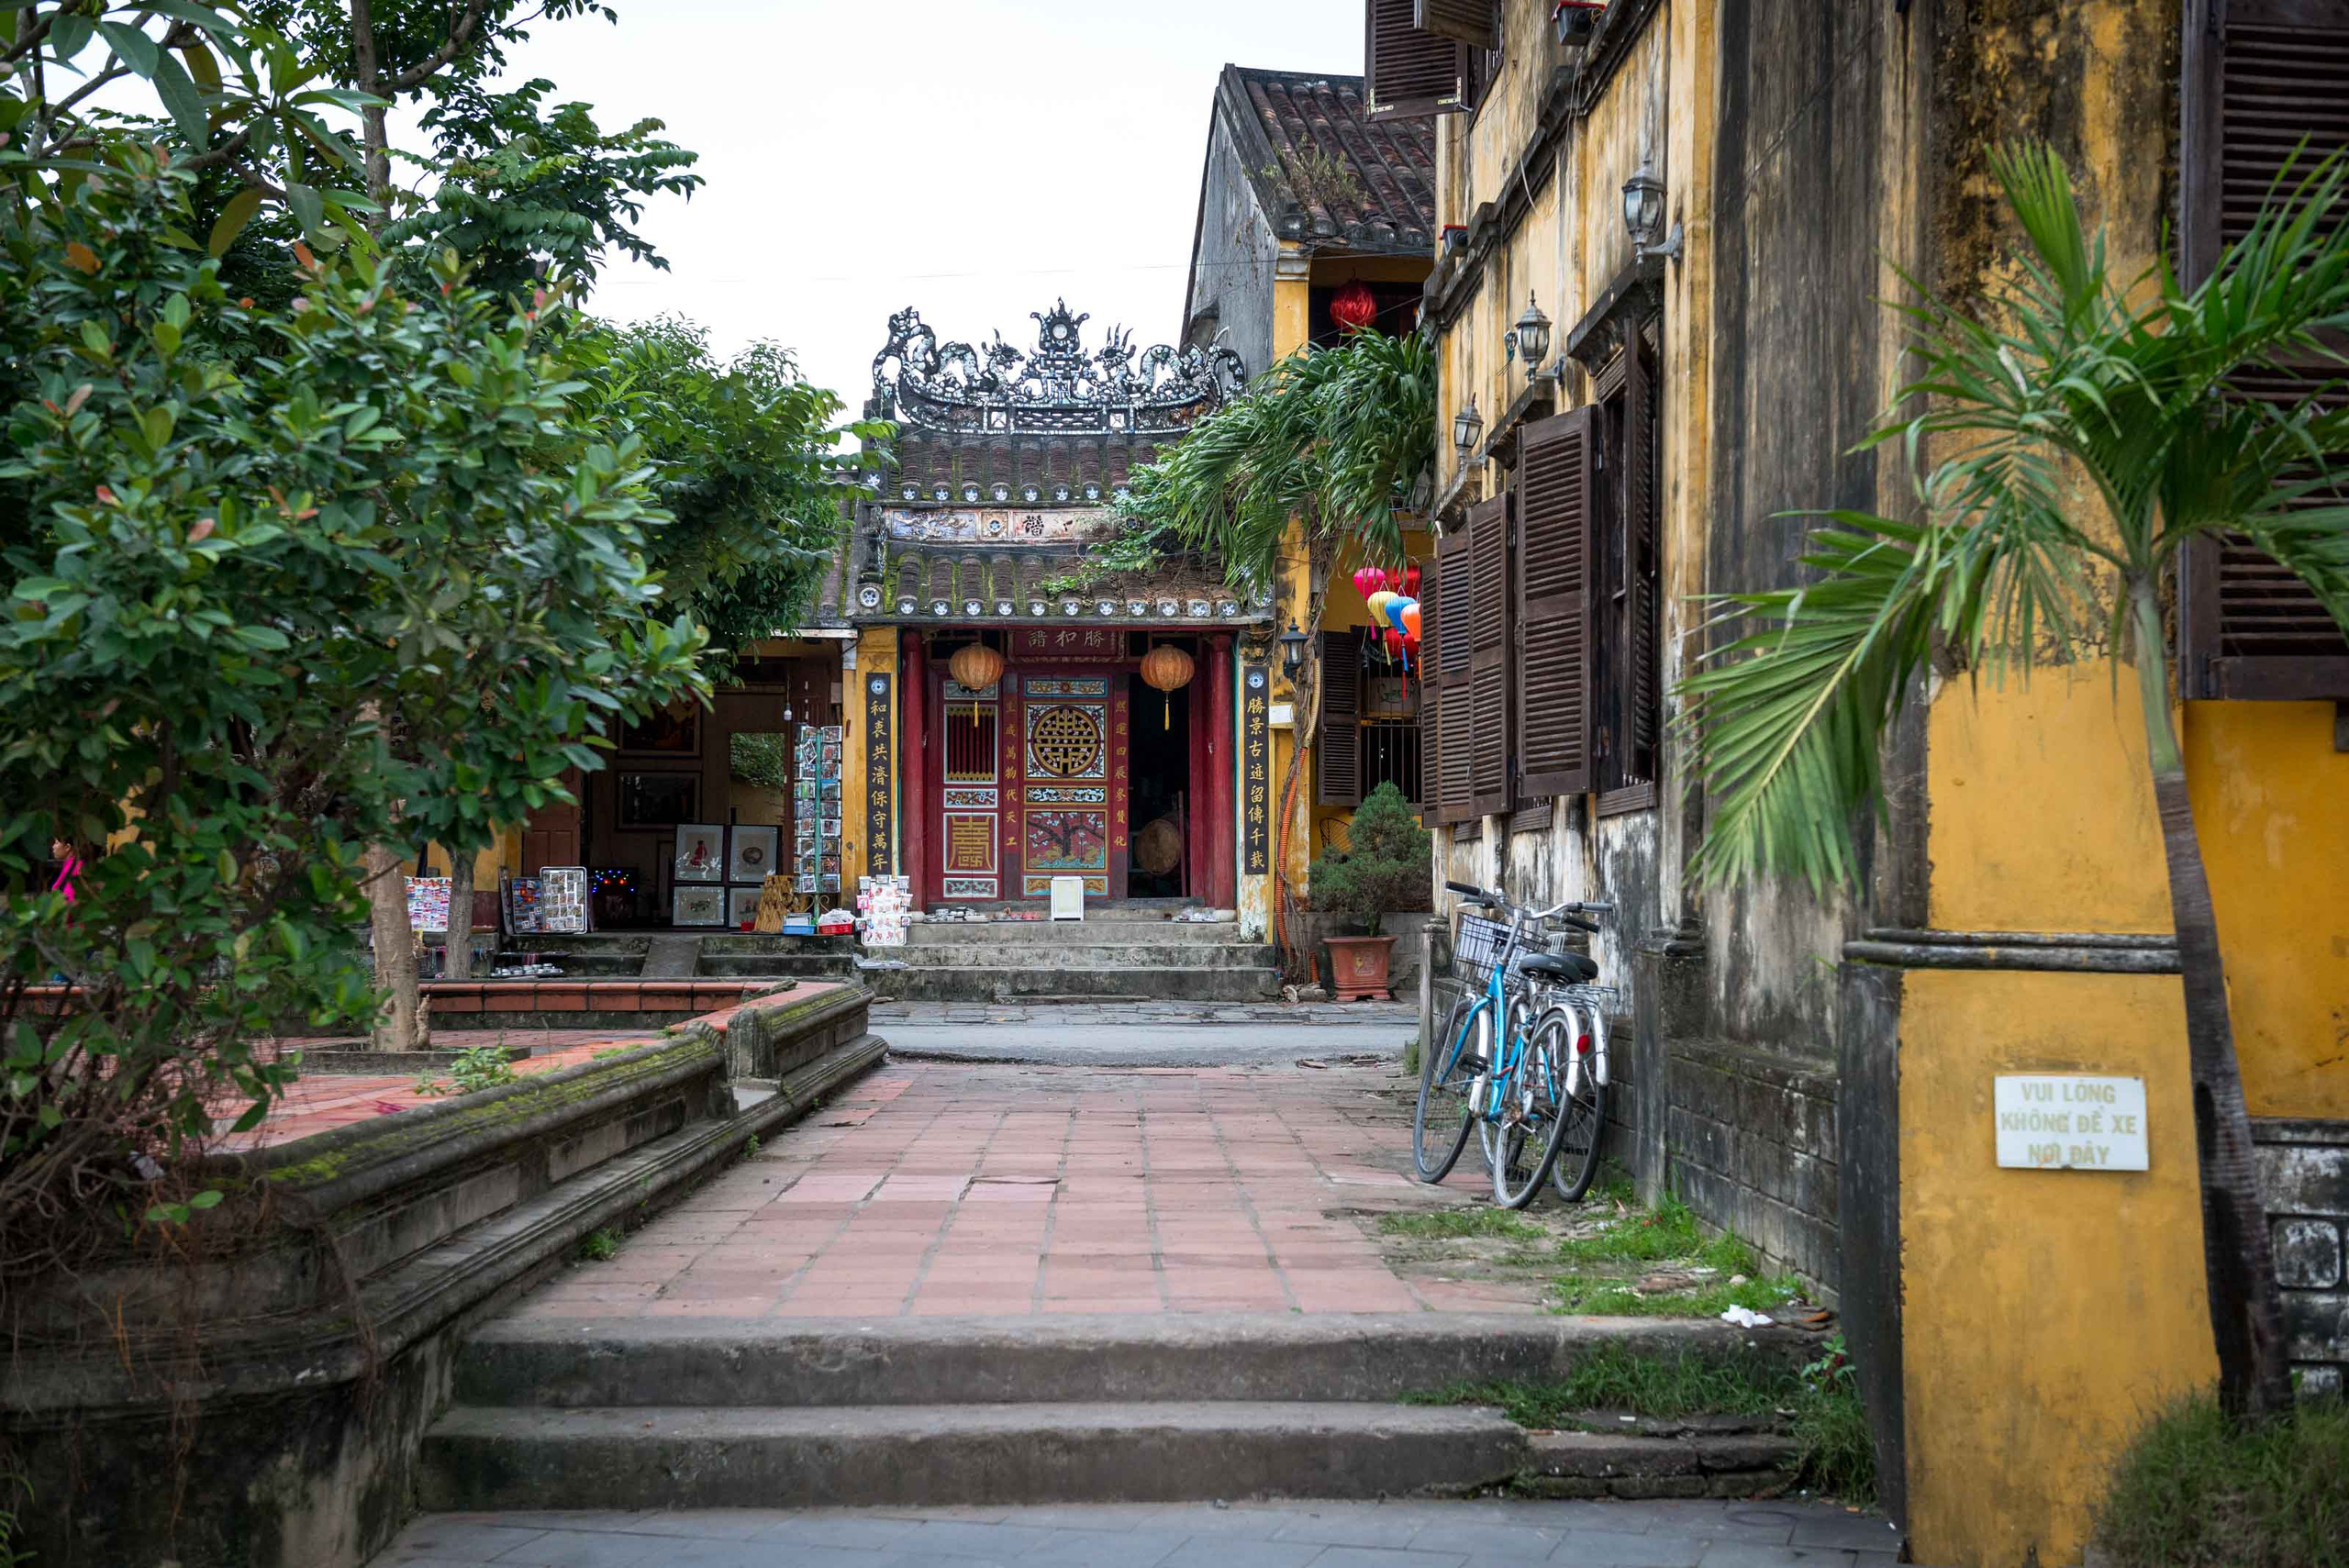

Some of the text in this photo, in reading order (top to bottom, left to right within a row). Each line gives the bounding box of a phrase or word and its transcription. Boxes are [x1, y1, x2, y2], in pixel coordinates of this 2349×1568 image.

[2021, 1083, 2054, 1102] VUI
[2000, 1108, 2070, 1134] KHÔNG
[2112, 1115, 2137, 1134] XE
[2067, 1140, 2110, 1164] ĐÂY
